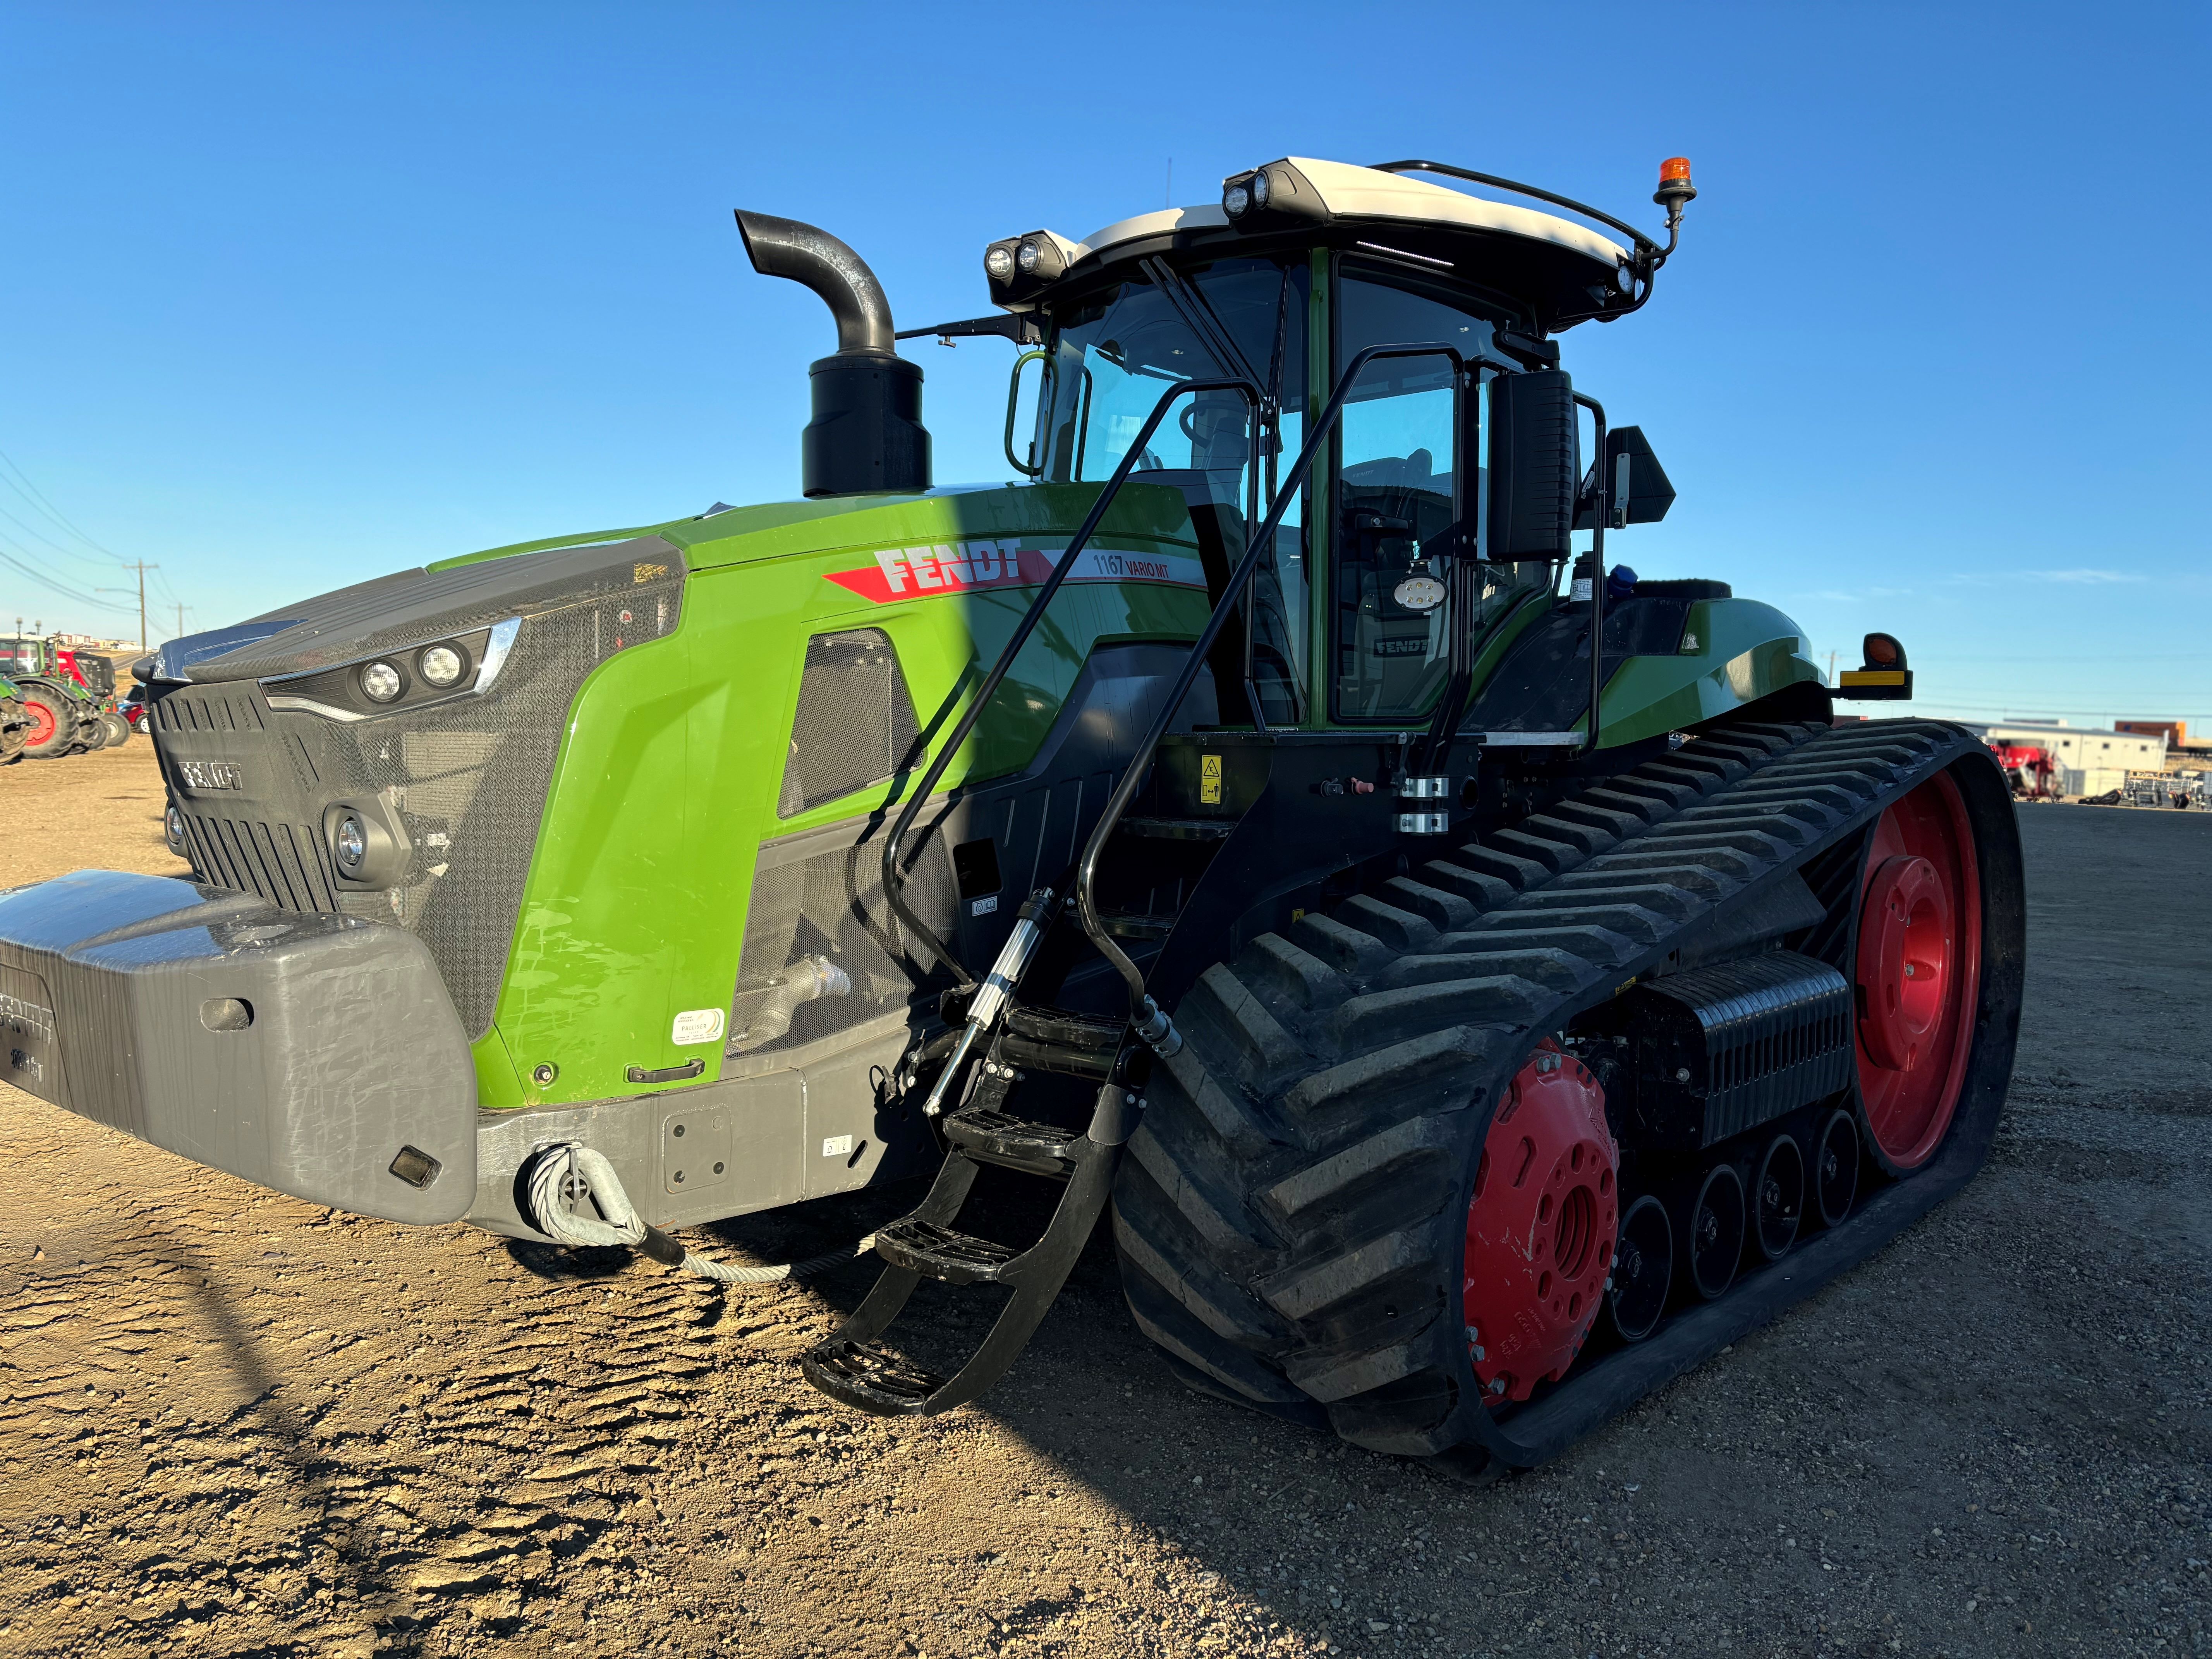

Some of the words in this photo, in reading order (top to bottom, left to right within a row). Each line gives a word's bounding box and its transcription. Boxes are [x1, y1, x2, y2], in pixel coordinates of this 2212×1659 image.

[874, 538, 1021, 593] FENDT
[1093, 555, 1123, 575] 1167
[1125, 561, 1155, 577] VARIO
[1155, 563, 1169, 579] MT
[1376, 639, 1431, 653] FENDT
[178, 762, 243, 789] FENDT
